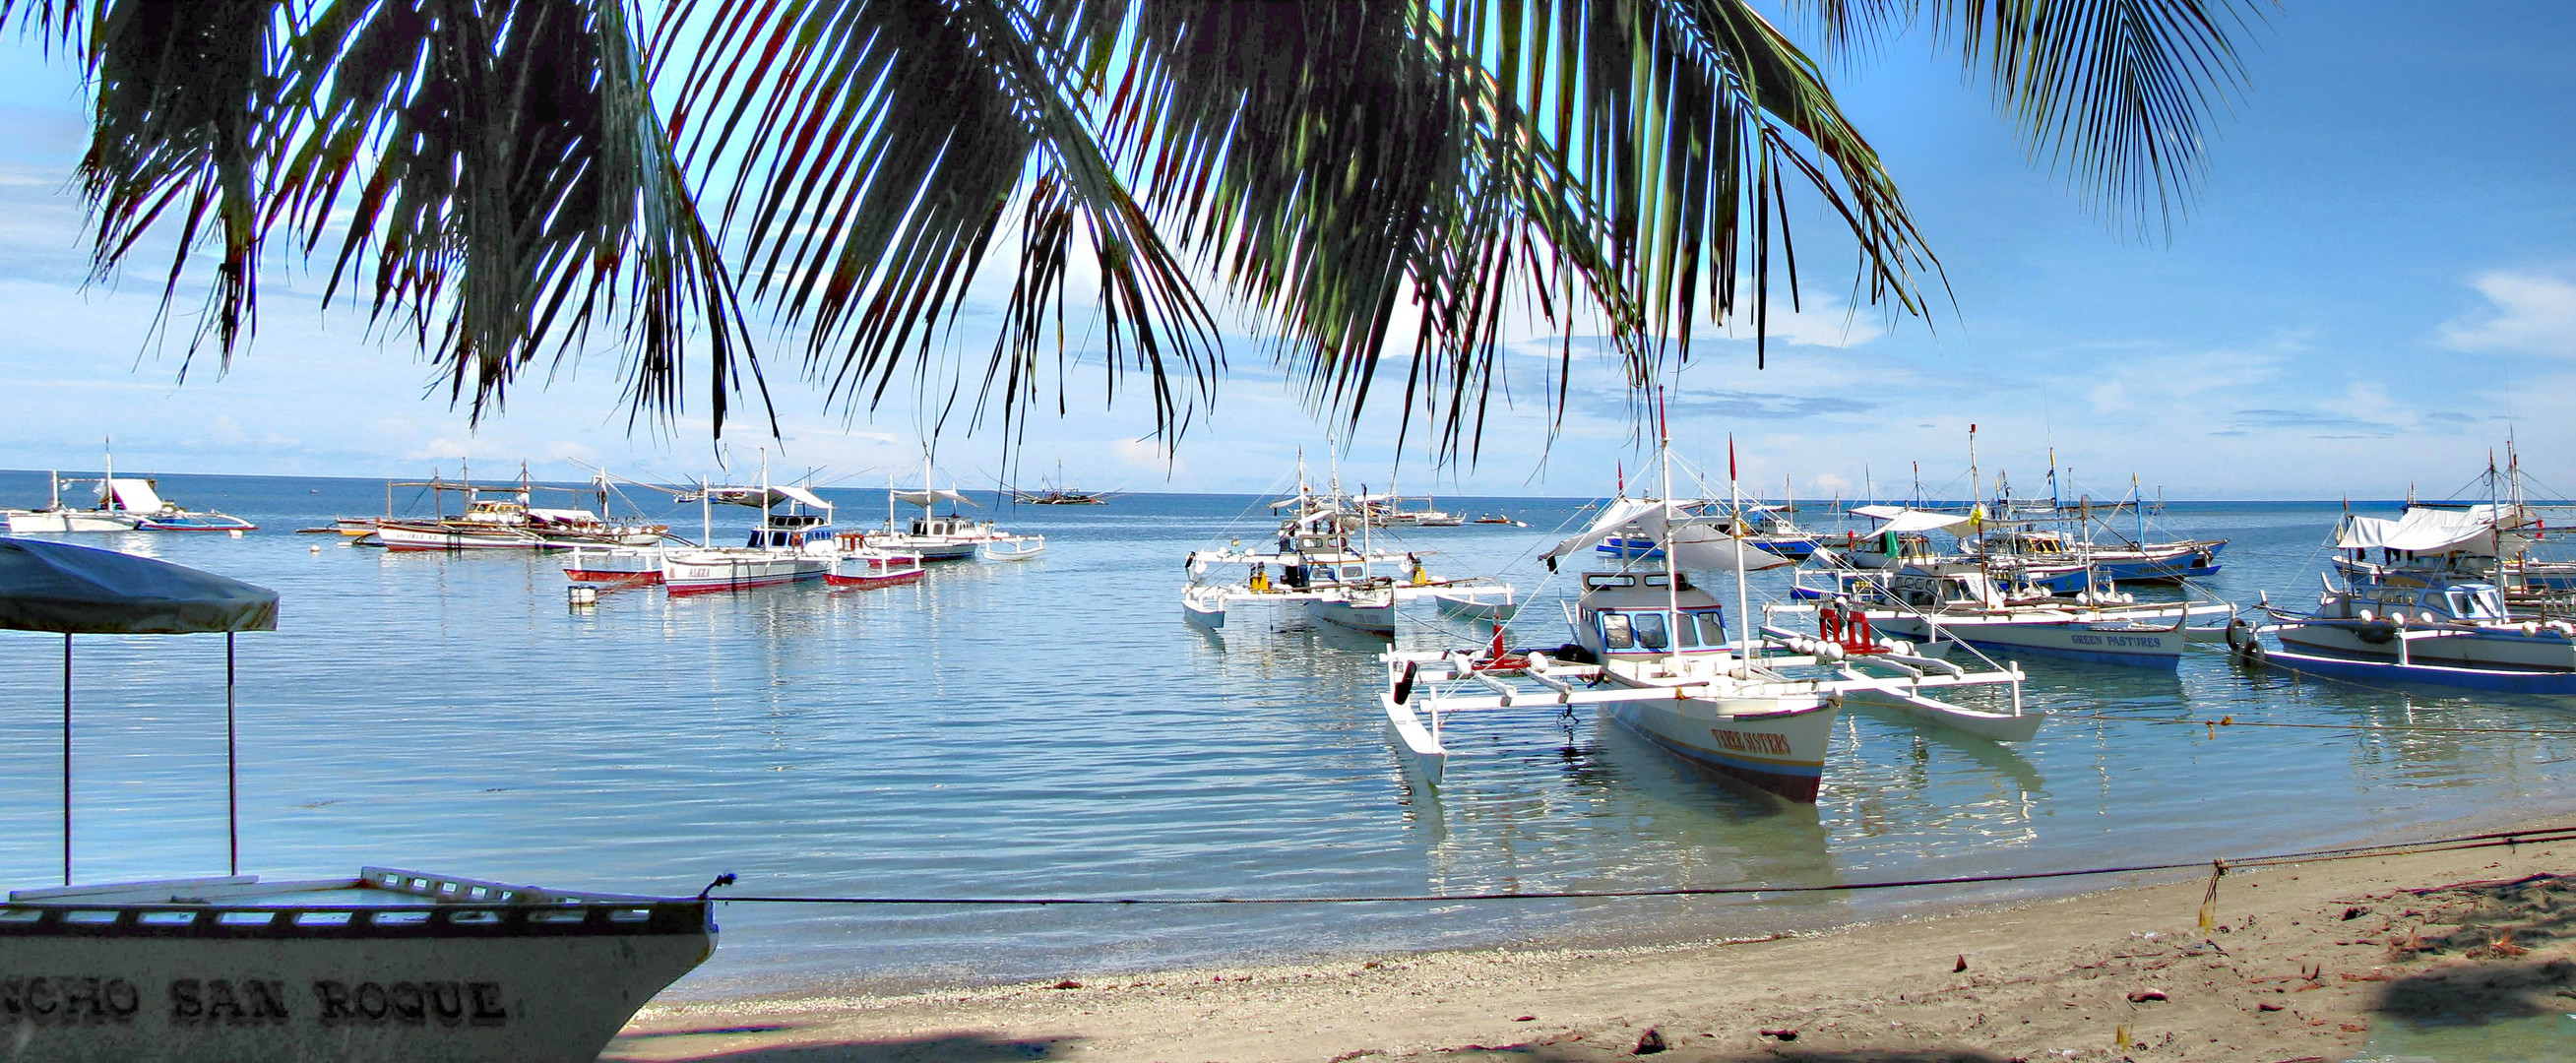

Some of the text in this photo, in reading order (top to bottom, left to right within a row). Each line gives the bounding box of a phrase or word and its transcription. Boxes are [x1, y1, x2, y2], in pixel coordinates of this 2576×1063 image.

[2071, 635, 2161, 648] GREEN PASTURES
[1743, 732, 1792, 756] SISTERS
[169, 978, 289, 1025] SAN
[313, 980, 508, 1027] ROQUE
